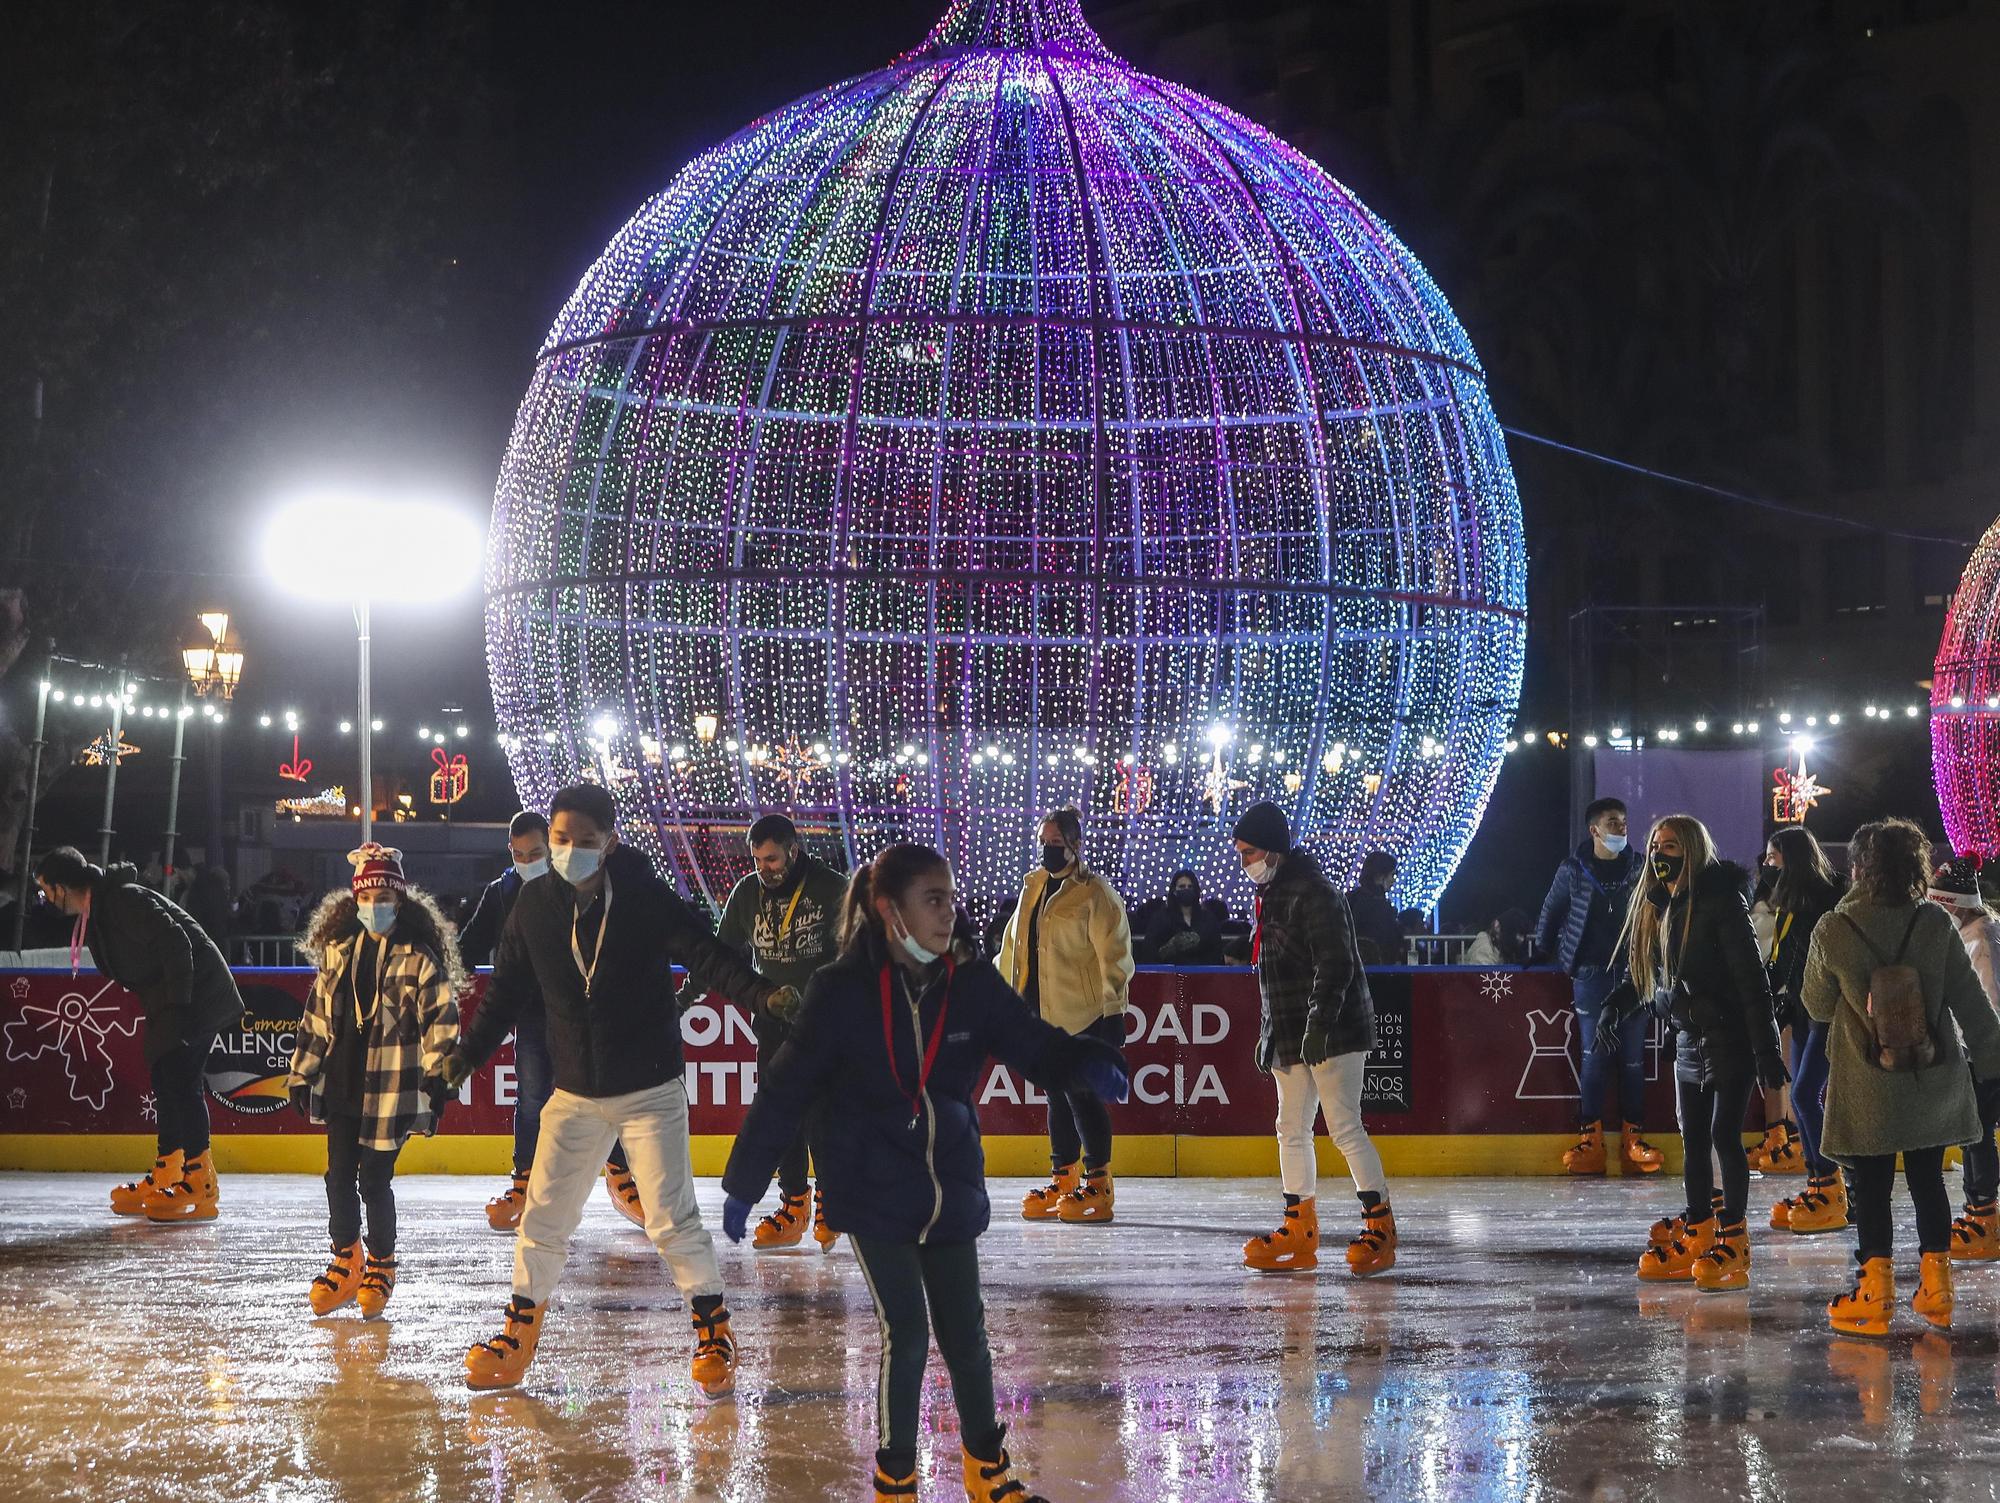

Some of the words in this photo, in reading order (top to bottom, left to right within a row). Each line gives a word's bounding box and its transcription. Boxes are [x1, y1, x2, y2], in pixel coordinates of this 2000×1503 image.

[353, 877, 387, 891] SANTA
[1375, 1025, 1402, 1035] IOS
[209, 1032, 295, 1055] ALENC
[1377, 1038, 1402, 1048] CIA
[212, 1090, 235, 1109] CENTRO
[235, 1104, 275, 1114] COMERCIAL
